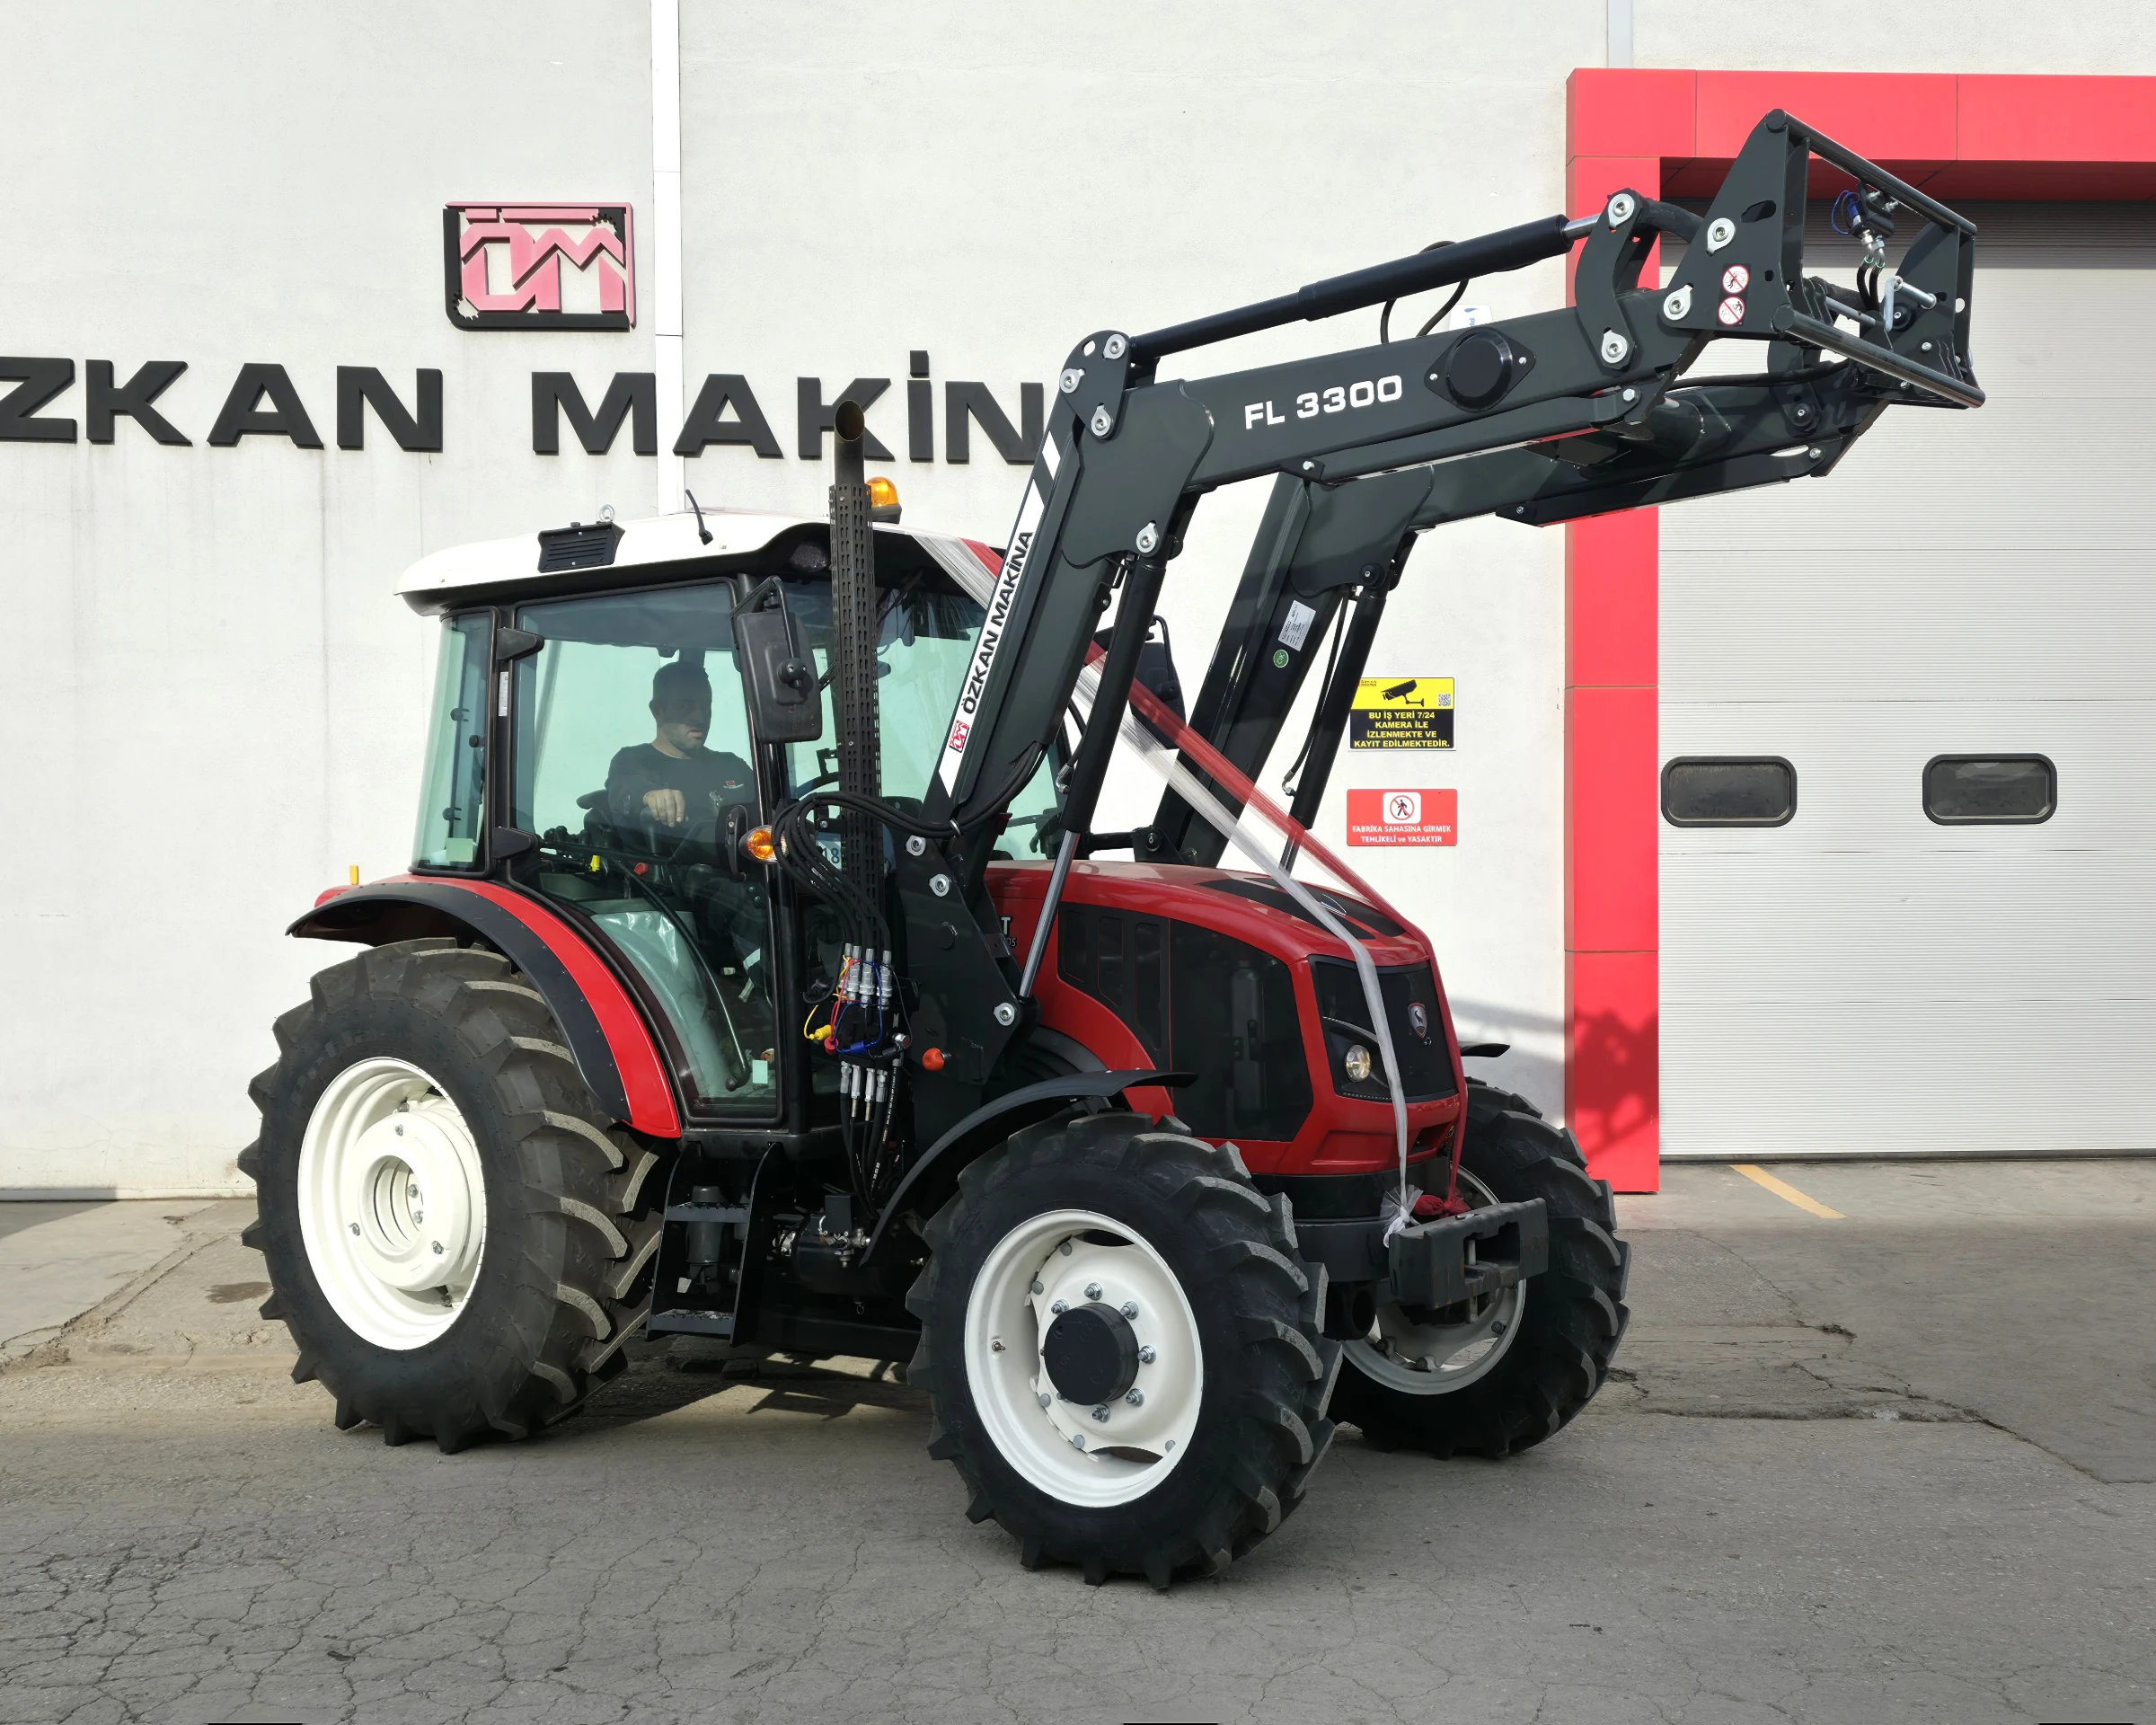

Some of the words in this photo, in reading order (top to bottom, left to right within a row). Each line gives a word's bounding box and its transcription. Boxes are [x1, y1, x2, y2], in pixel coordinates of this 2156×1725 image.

[1244, 400, 1286, 429] FL
[1296, 375, 1402, 419] 3300
[961, 630, 999, 714] ÖZKAN
[990, 531, 1034, 627] MAKİNA
[1383, 711, 1392, 720] İŞ
[1394, 711, 1415, 719] YERİ
[1415, 720, 1429, 729] İLE
[1366, 730, 1423, 738] İZLENMEKTE
[1383, 739, 1450, 748] EDİLMEKTEDİR.
[1352, 825, 1383, 833] FABRİKA
[1384, 825, 1422, 833] SAHASINA
[1423, 824, 1452, 833] GİRMEK
[1361, 835, 1397, 843] TEHLİKELİ
